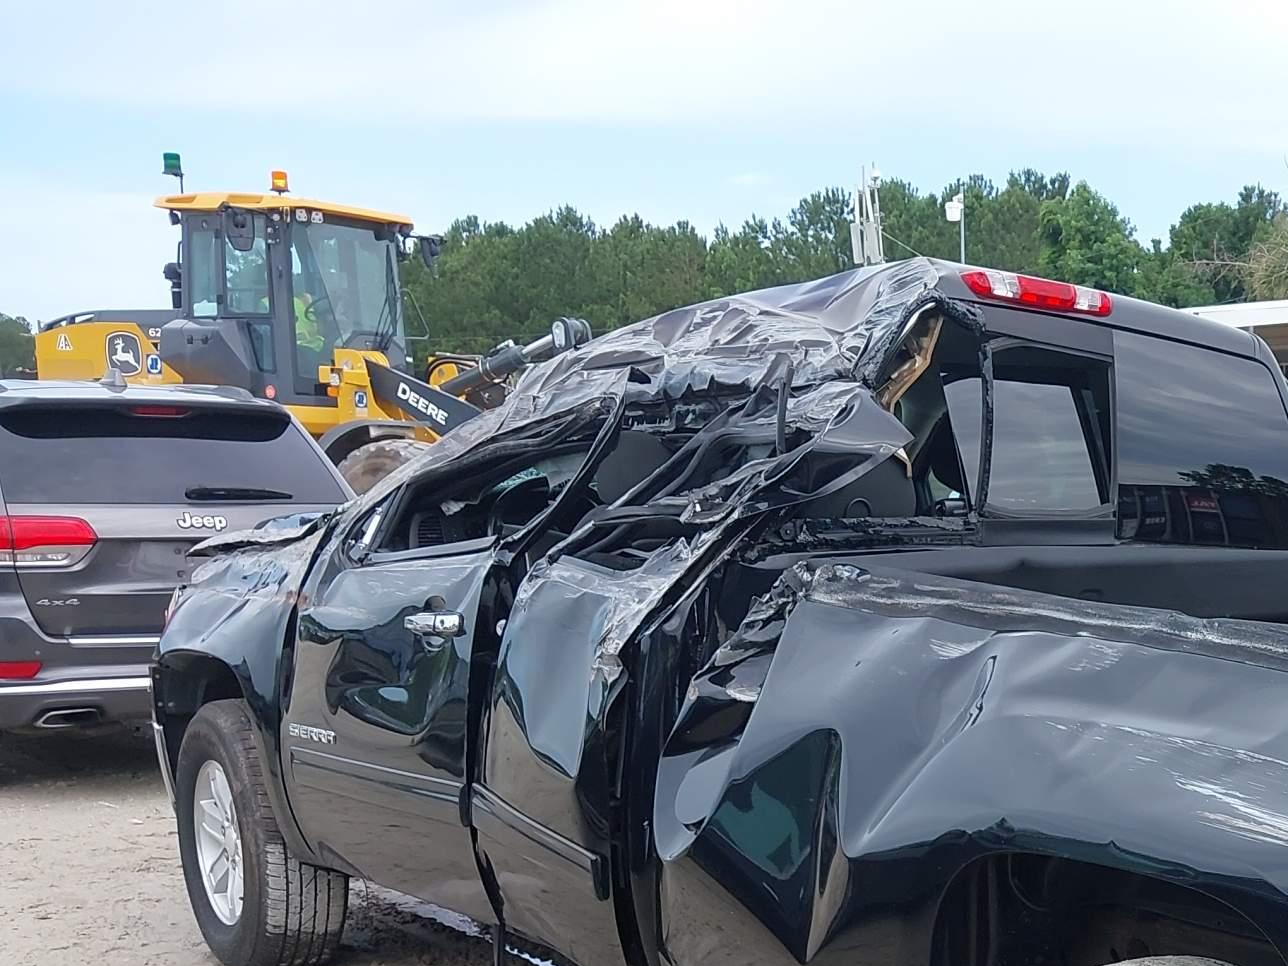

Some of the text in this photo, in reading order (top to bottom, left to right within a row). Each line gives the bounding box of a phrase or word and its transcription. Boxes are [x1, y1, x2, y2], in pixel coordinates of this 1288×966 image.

[397, 381, 450, 426] DEERE
[176, 511, 228, 532] Jeep
[288, 722, 337, 745] SIERRA
